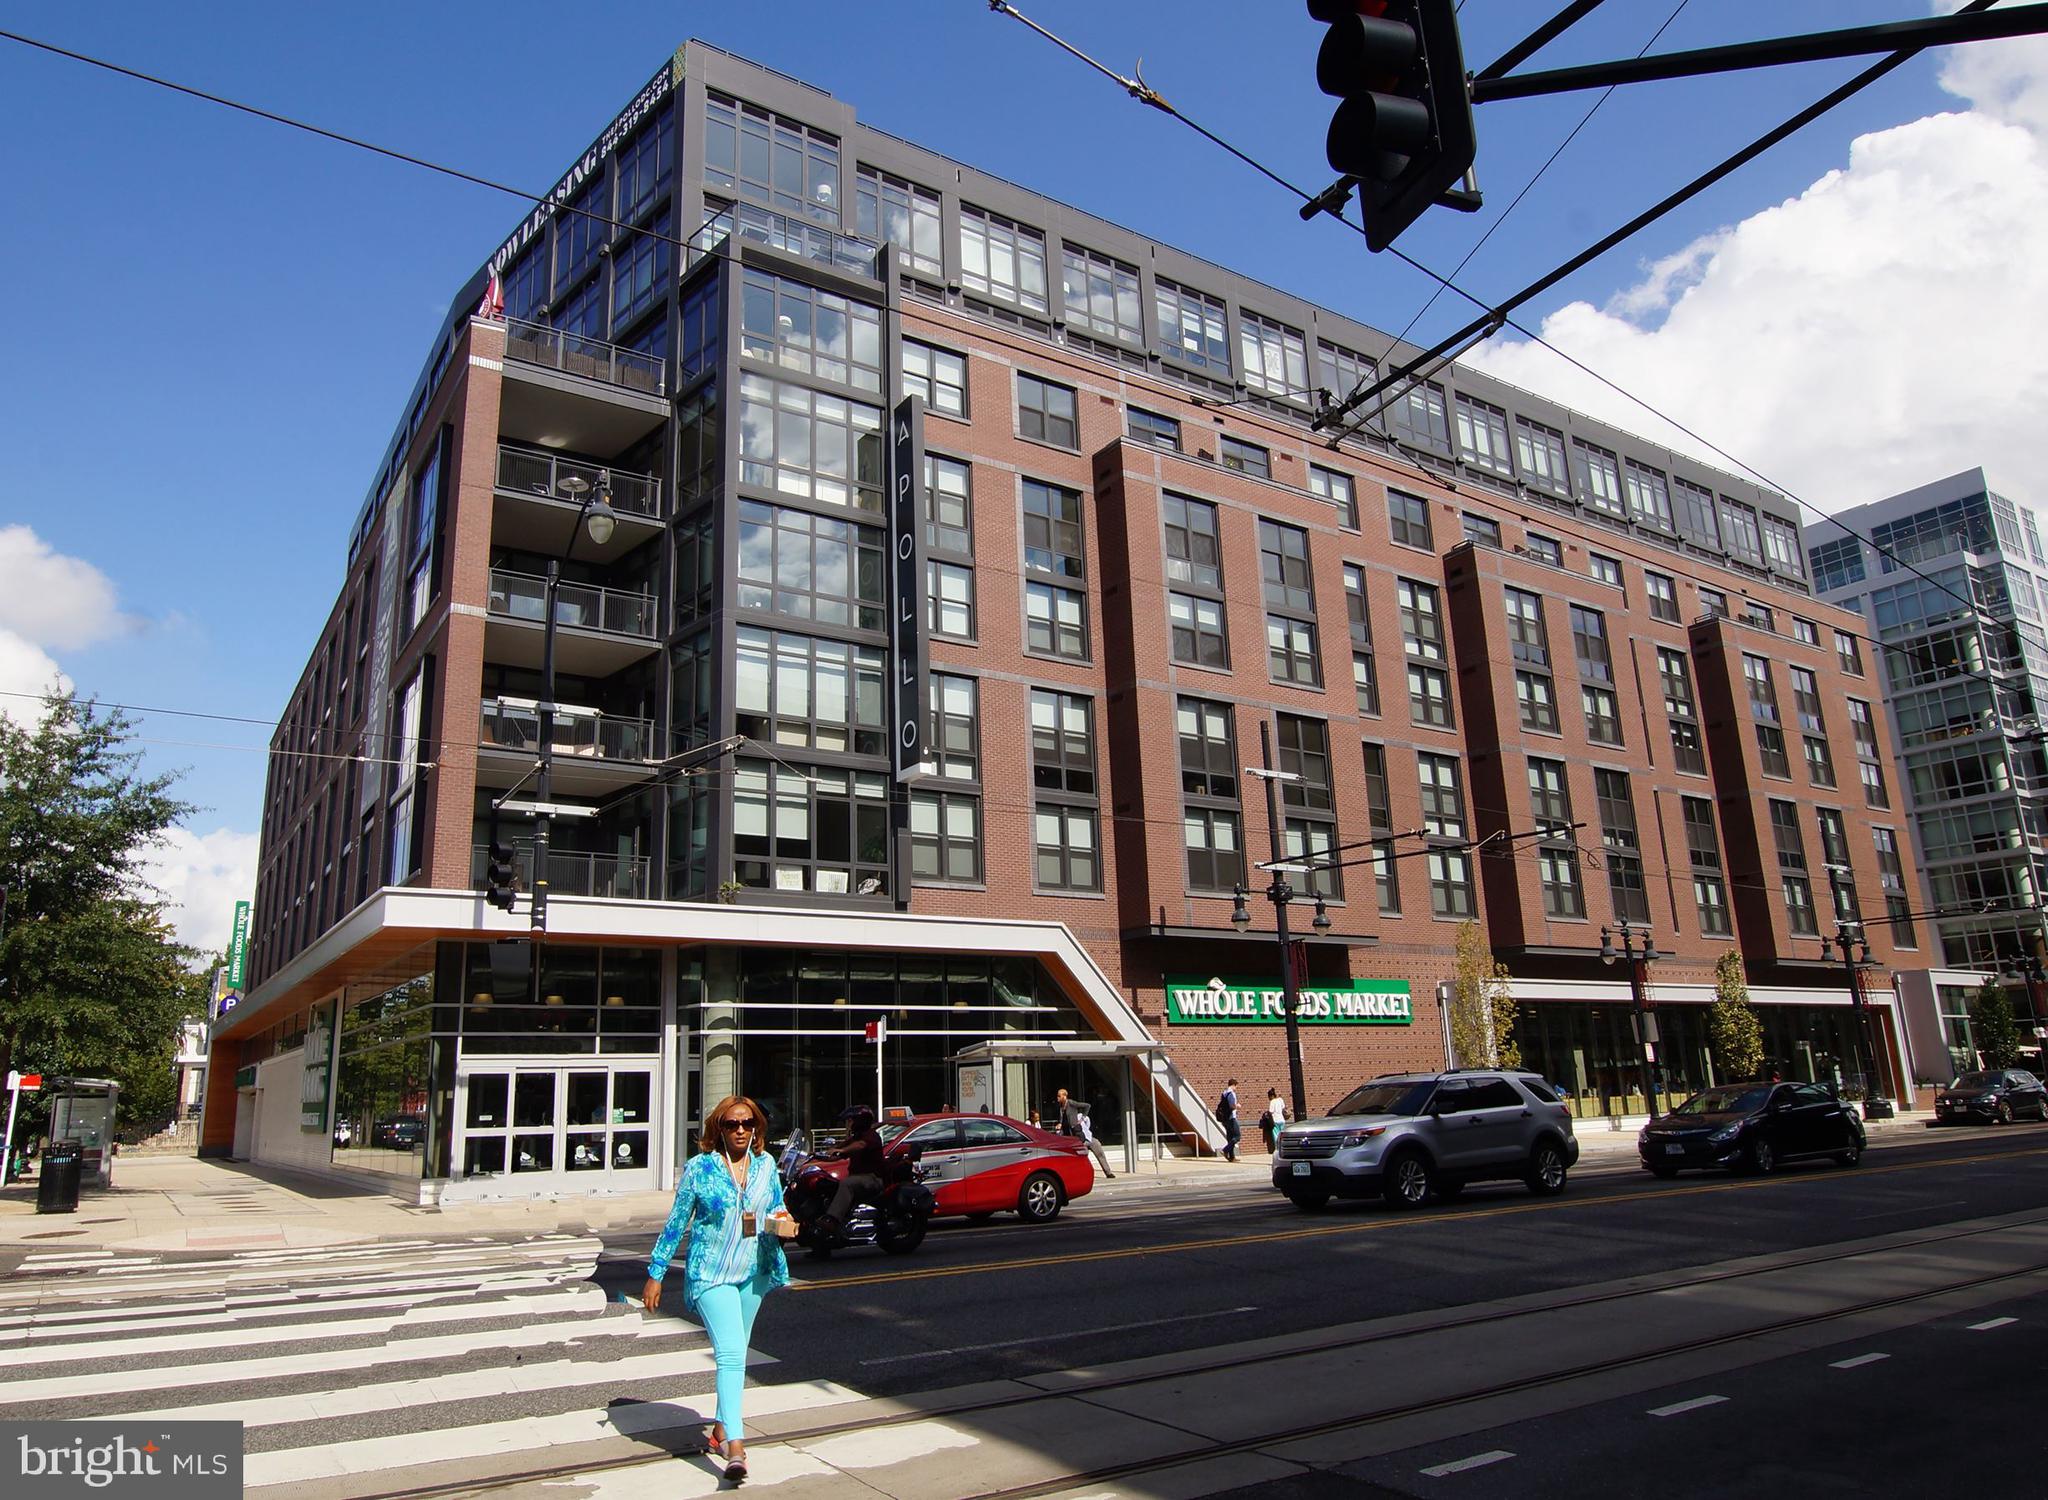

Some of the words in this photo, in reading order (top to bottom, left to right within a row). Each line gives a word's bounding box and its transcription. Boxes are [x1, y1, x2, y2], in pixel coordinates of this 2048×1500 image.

[601, 80, 669, 159] 844-319-8454
[522, 146, 597, 246] LEASING
[897, 420, 917, 749] APOLLO
[226, 998, 237, 1010] P
[1173, 984, 1255, 1016] WHOLE
[1260, 990, 1331, 1016] FOODS
[1334, 993, 1411, 1017] MARKET
